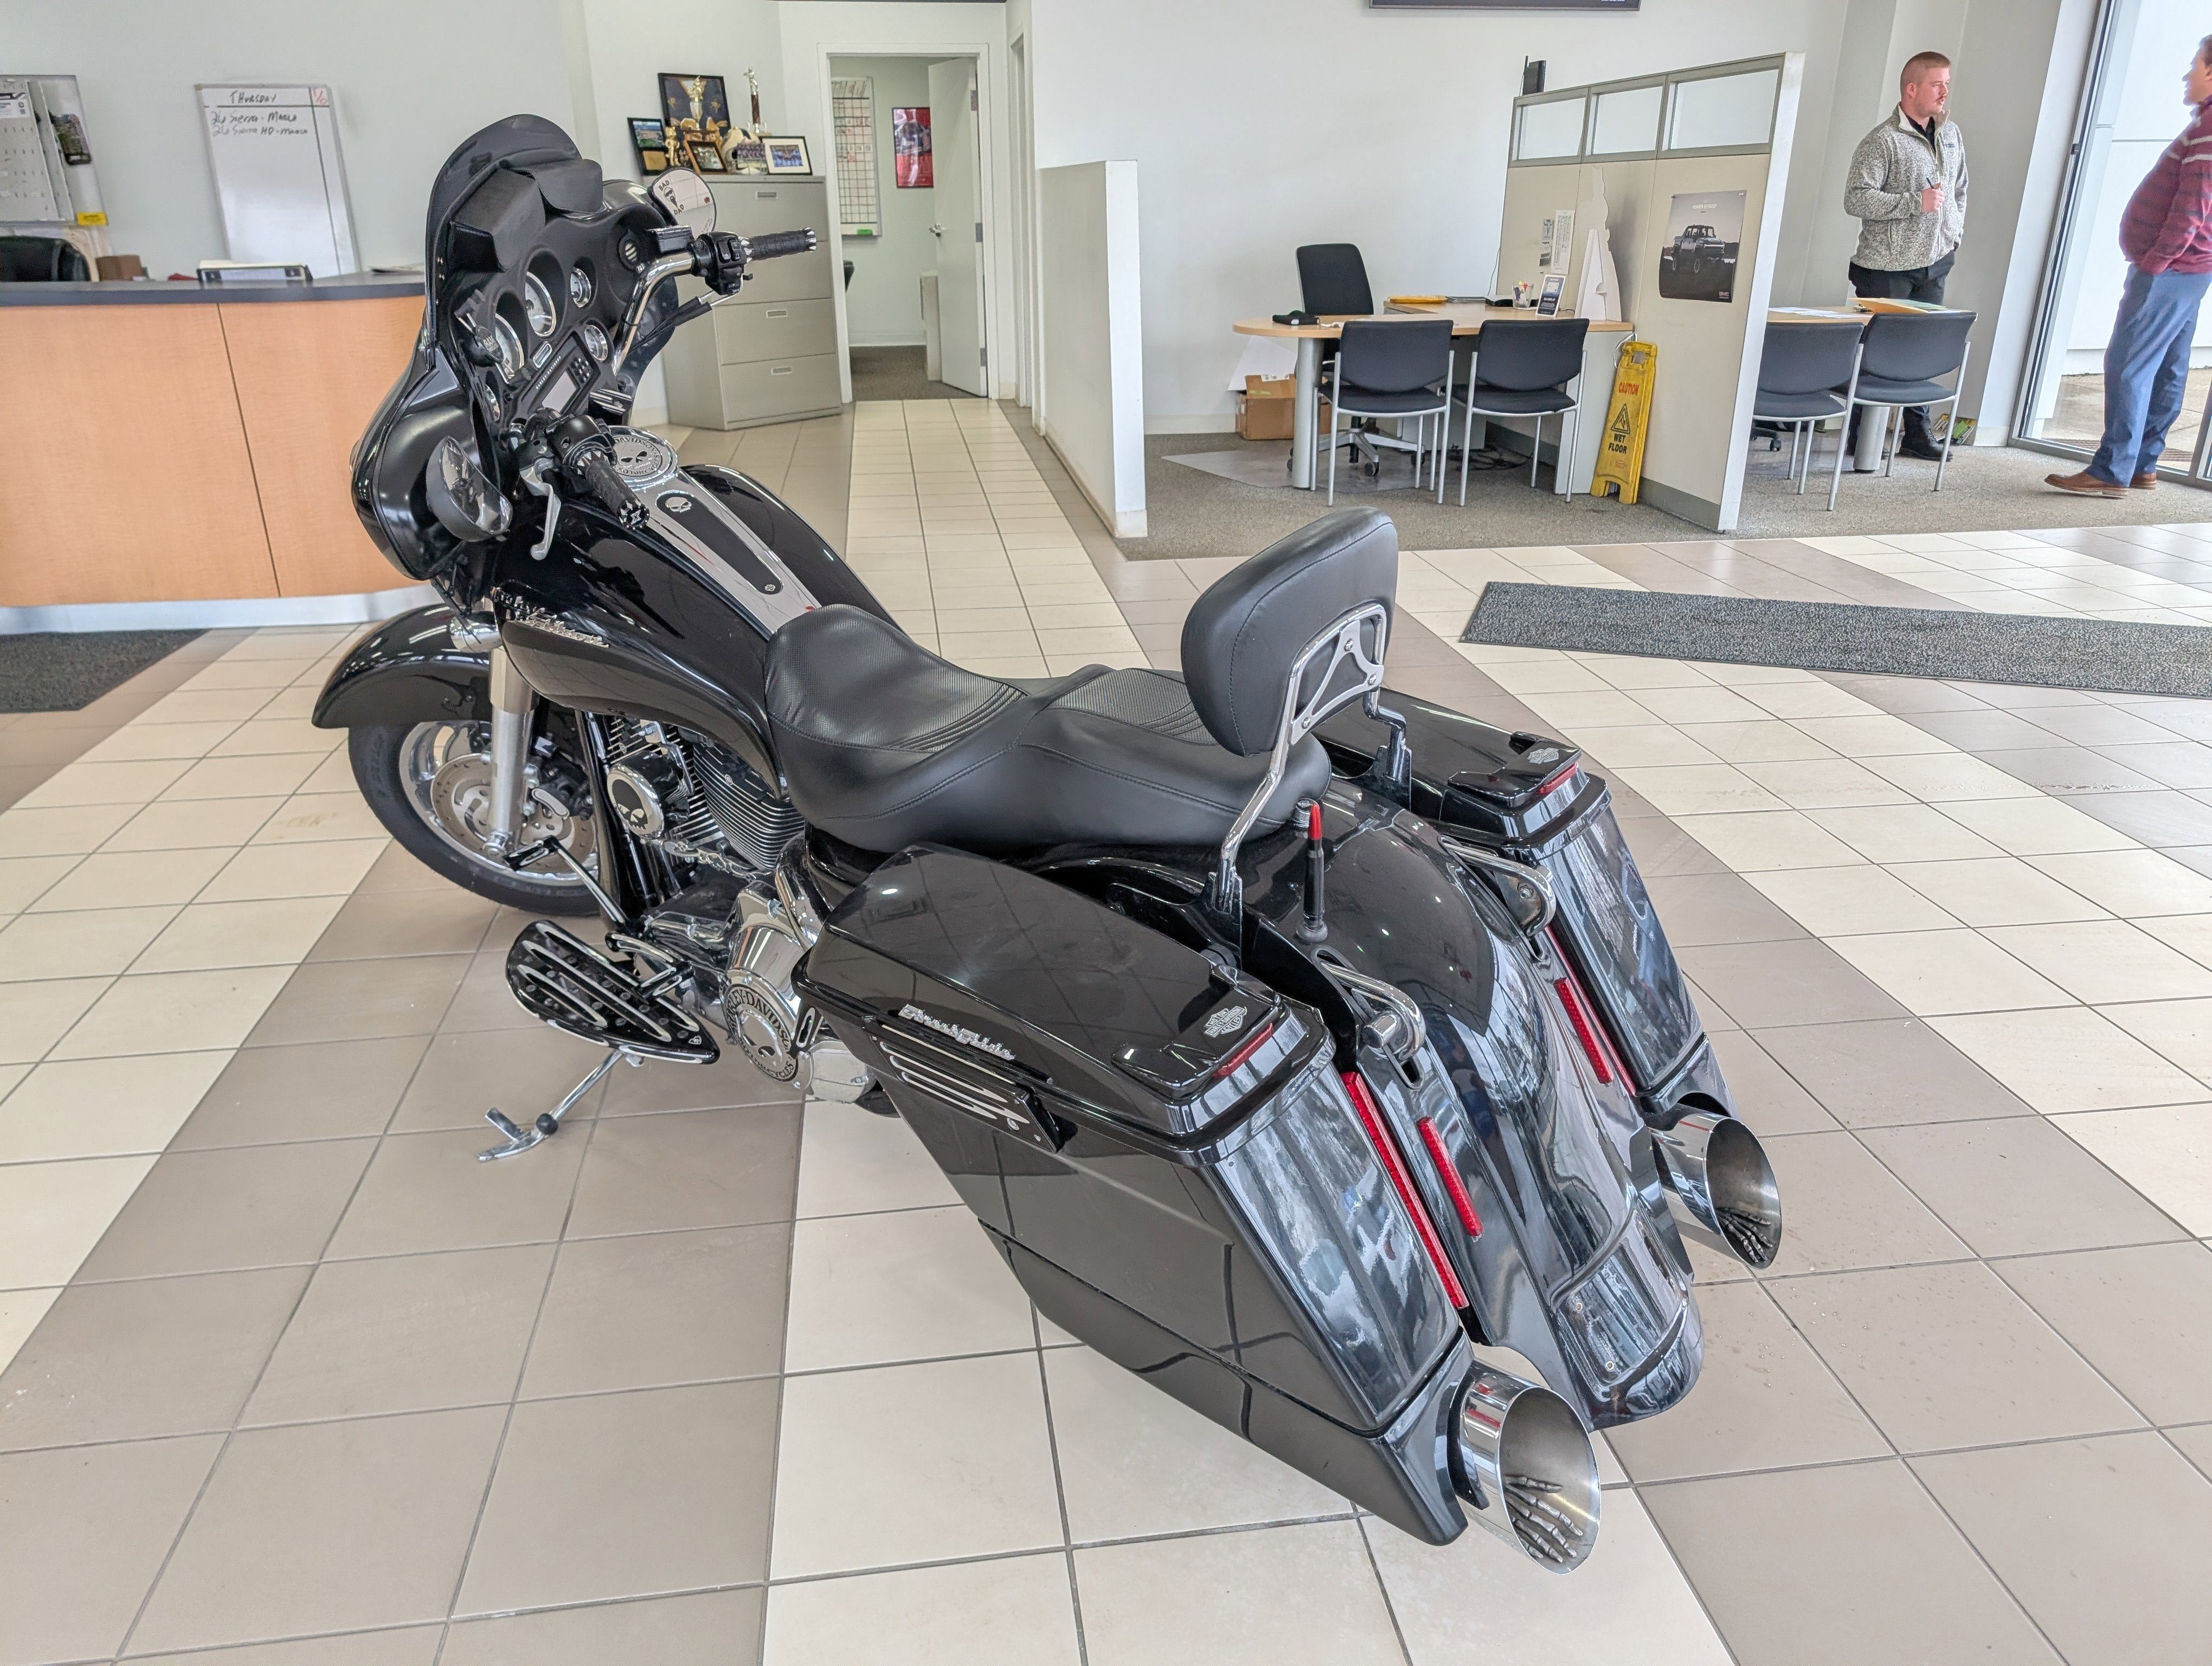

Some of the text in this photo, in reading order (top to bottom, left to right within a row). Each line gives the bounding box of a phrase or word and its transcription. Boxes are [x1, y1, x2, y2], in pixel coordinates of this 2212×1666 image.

[658, 180, 670, 191] BAD
[673, 204, 684, 215] DAD
[1618, 382, 1639, 395] CAUTION
[1613, 433, 1626, 443] WET
[1608, 442, 1627, 454] FLOOR
[726, 989, 790, 1050] HARLEY-DAVIDSO
